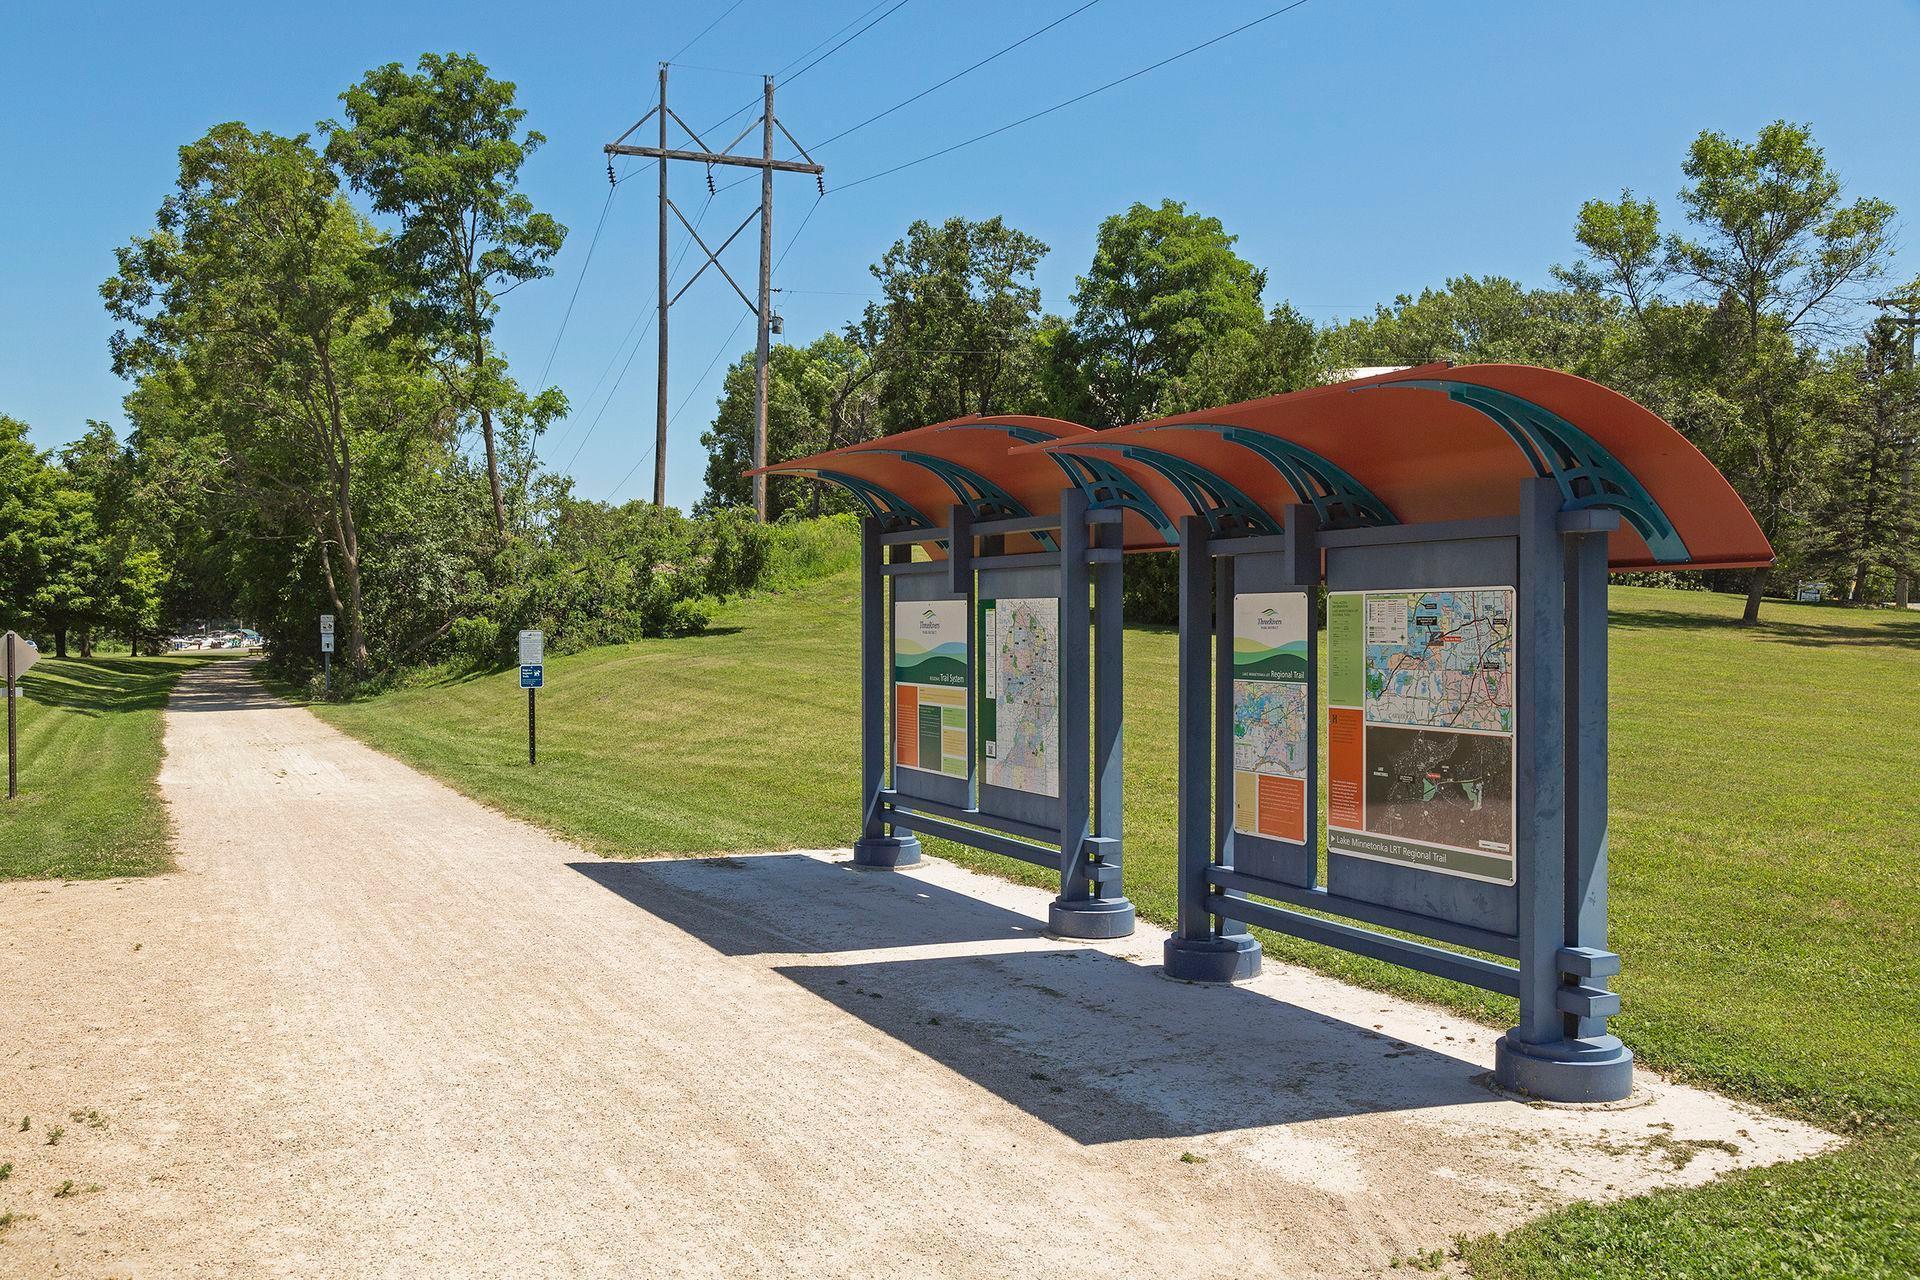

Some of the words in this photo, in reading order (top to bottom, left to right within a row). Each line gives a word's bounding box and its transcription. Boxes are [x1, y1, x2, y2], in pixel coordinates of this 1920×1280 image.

[940, 673, 949, 682] Trail
[949, 673, 965, 684] System
[1270, 670, 1293, 679] Regional
[1293, 671, 1305, 679] Trail
[1336, 835, 1350, 845] Lake
[1351, 837, 1388, 852] Minnetonka
[1389, 844, 1402, 854] LRT
[1402, 847, 1431, 860] Regional
[1432, 852, 1447, 863] Trail
